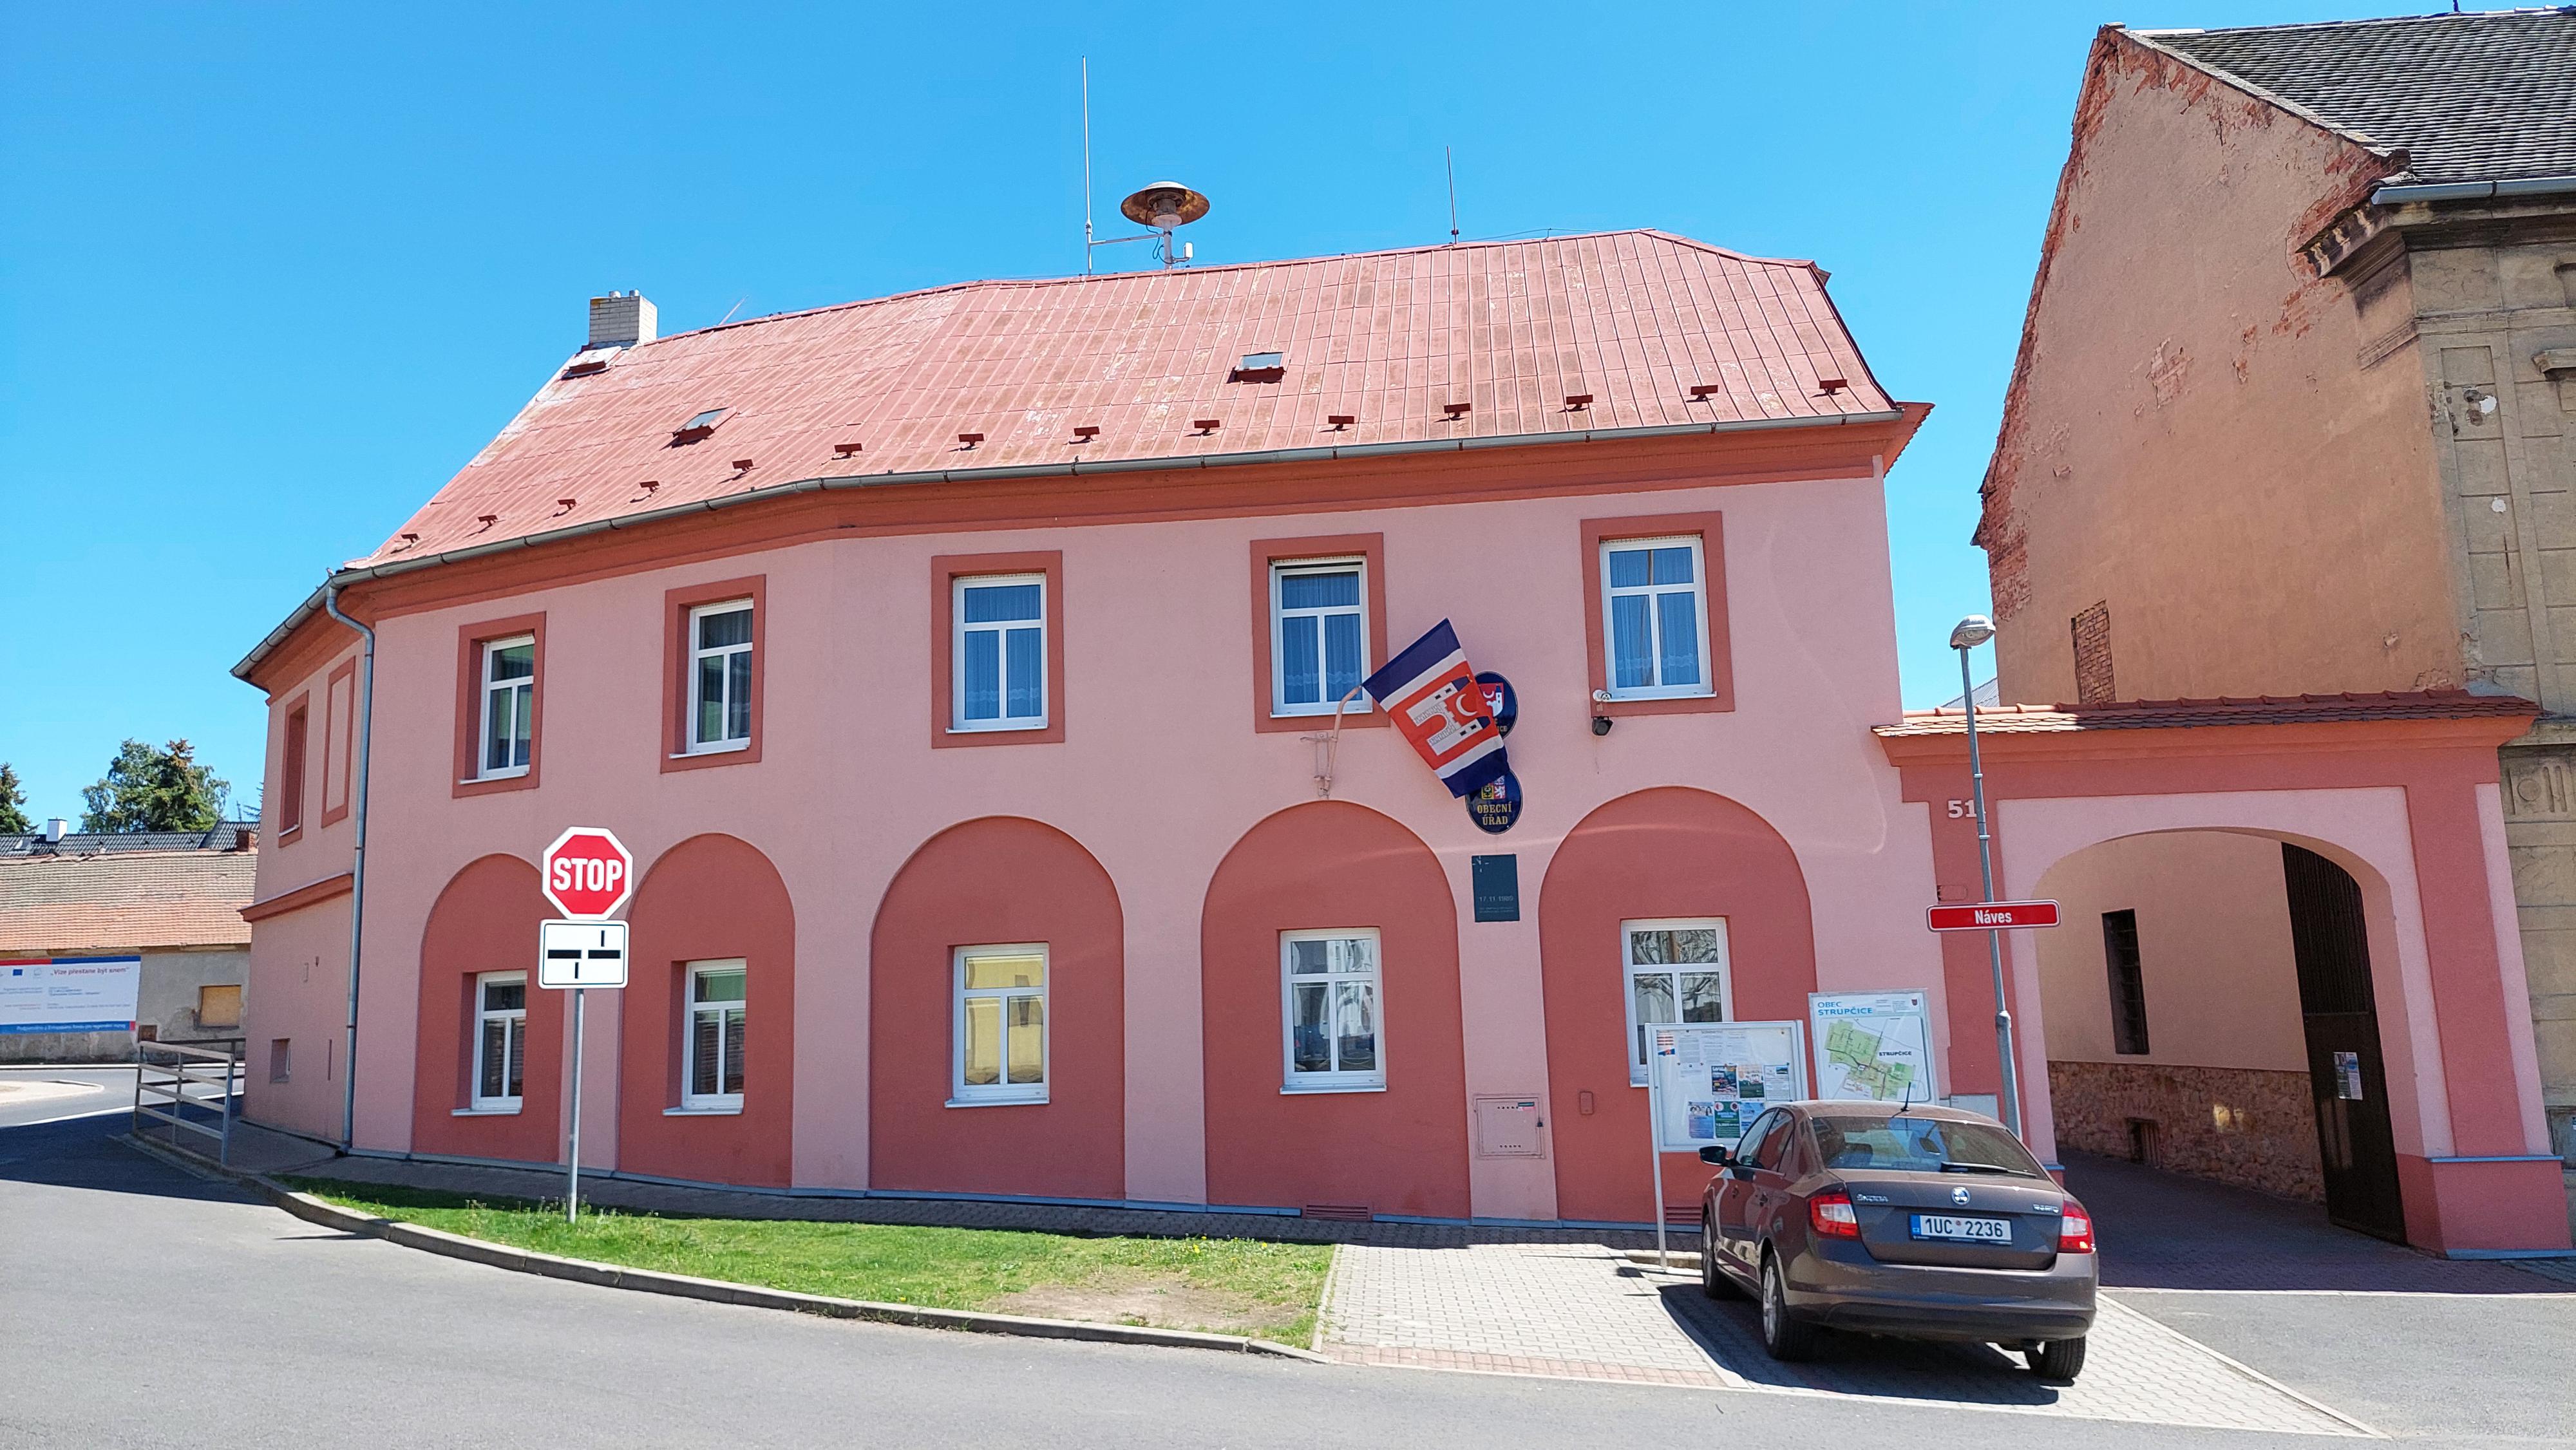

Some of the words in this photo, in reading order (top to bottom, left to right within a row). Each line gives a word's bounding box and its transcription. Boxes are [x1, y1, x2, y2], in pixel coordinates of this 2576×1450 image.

[1477, 801, 1512, 814] OBECNÍ
[1482, 814, 1508, 825] ÚŘAD
[553, 857, 623, 892] STOP
[1975, 910, 2012, 924] Náves
[1818, 1006, 1873, 1016] STRUPČICE
[1926, 1218, 1953, 1234] 1UC
[1965, 1222, 2003, 1238] 2236
